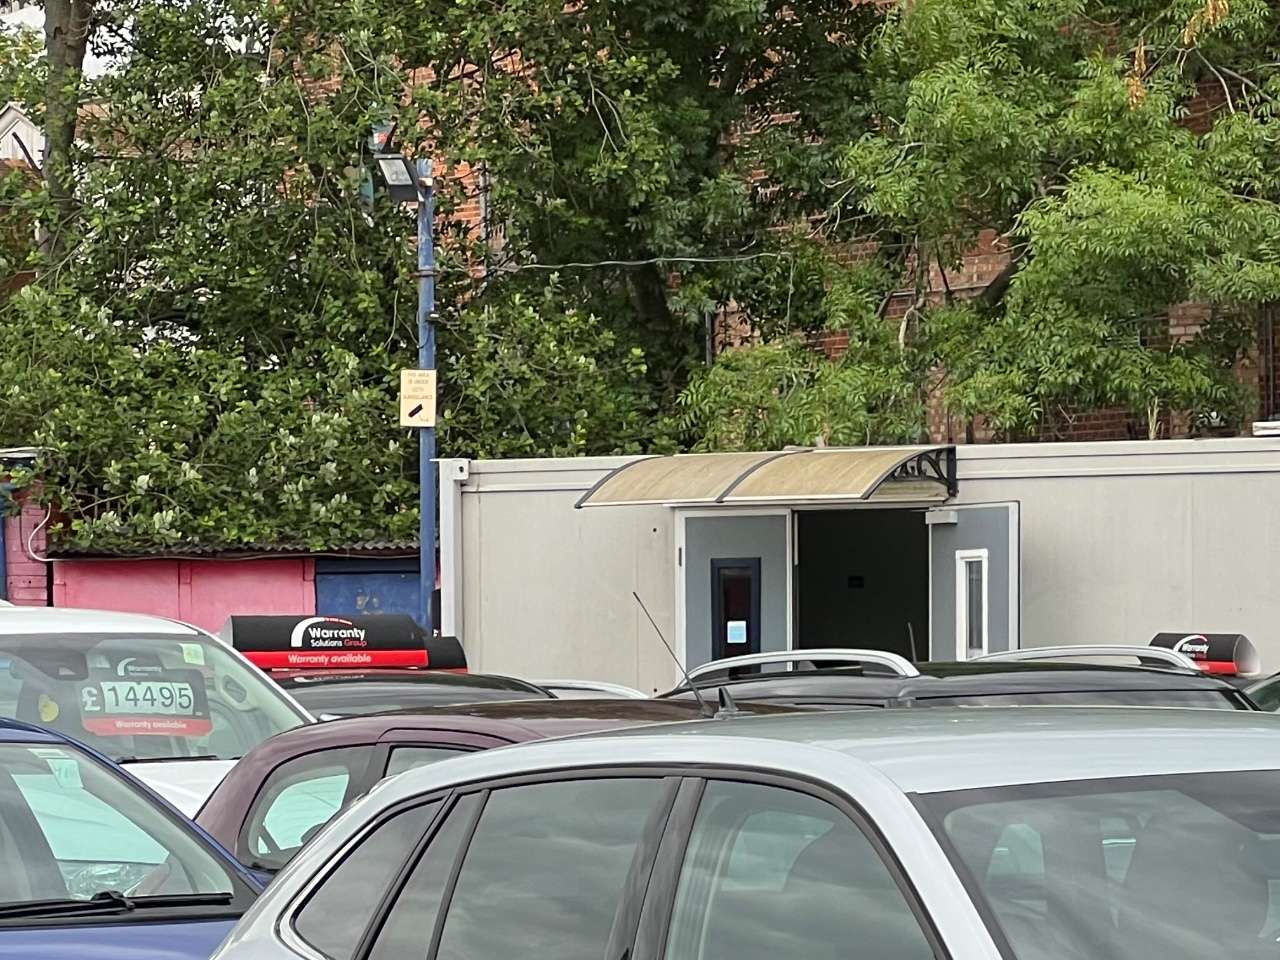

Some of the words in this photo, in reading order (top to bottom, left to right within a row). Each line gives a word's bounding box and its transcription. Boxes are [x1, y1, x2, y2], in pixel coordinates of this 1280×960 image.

[308, 627, 366, 641] Warranty
[310, 639, 343, 648] Solutions
[343, 639, 367, 648] Group
[287, 654, 330, 665] Warranty
[330, 653, 372, 664] available
